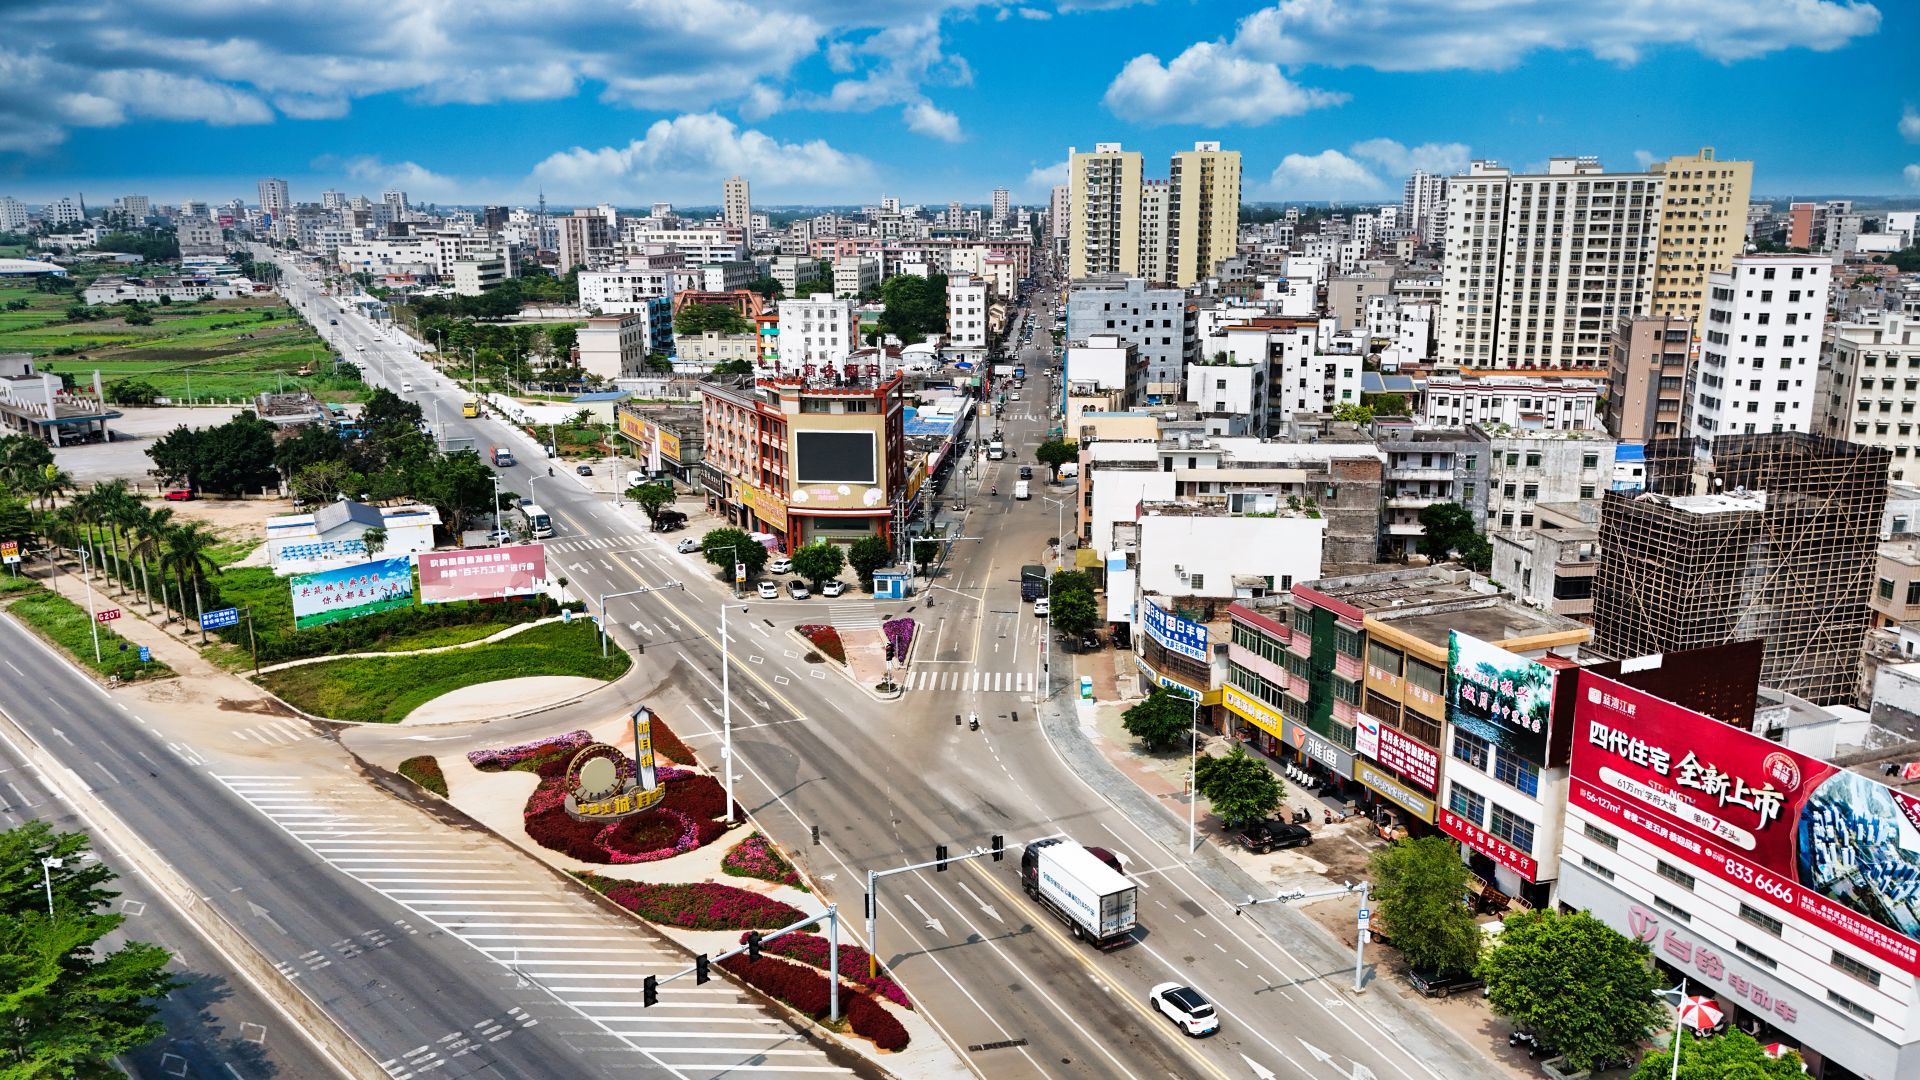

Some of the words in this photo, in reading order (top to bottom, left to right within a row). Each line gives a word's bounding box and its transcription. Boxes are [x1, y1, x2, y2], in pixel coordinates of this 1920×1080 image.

[322, 582, 398, 605] 你我都是主人翁
[98, 610, 120, 621] G207
[1176, 619, 1206, 641] 日丰管
[1602, 693, 1636, 716] 蓝湾江畔
[1308, 738, 1338, 767] 雅迪
[1588, 720, 1670, 775] 四代住宅
[1674, 750, 1784, 830] 全新上市
[1445, 814, 1529, 869] 城月永恒摩托车行
[1725, 859, 1753, 884] 833
[1755, 874, 1793, 903] 6666
